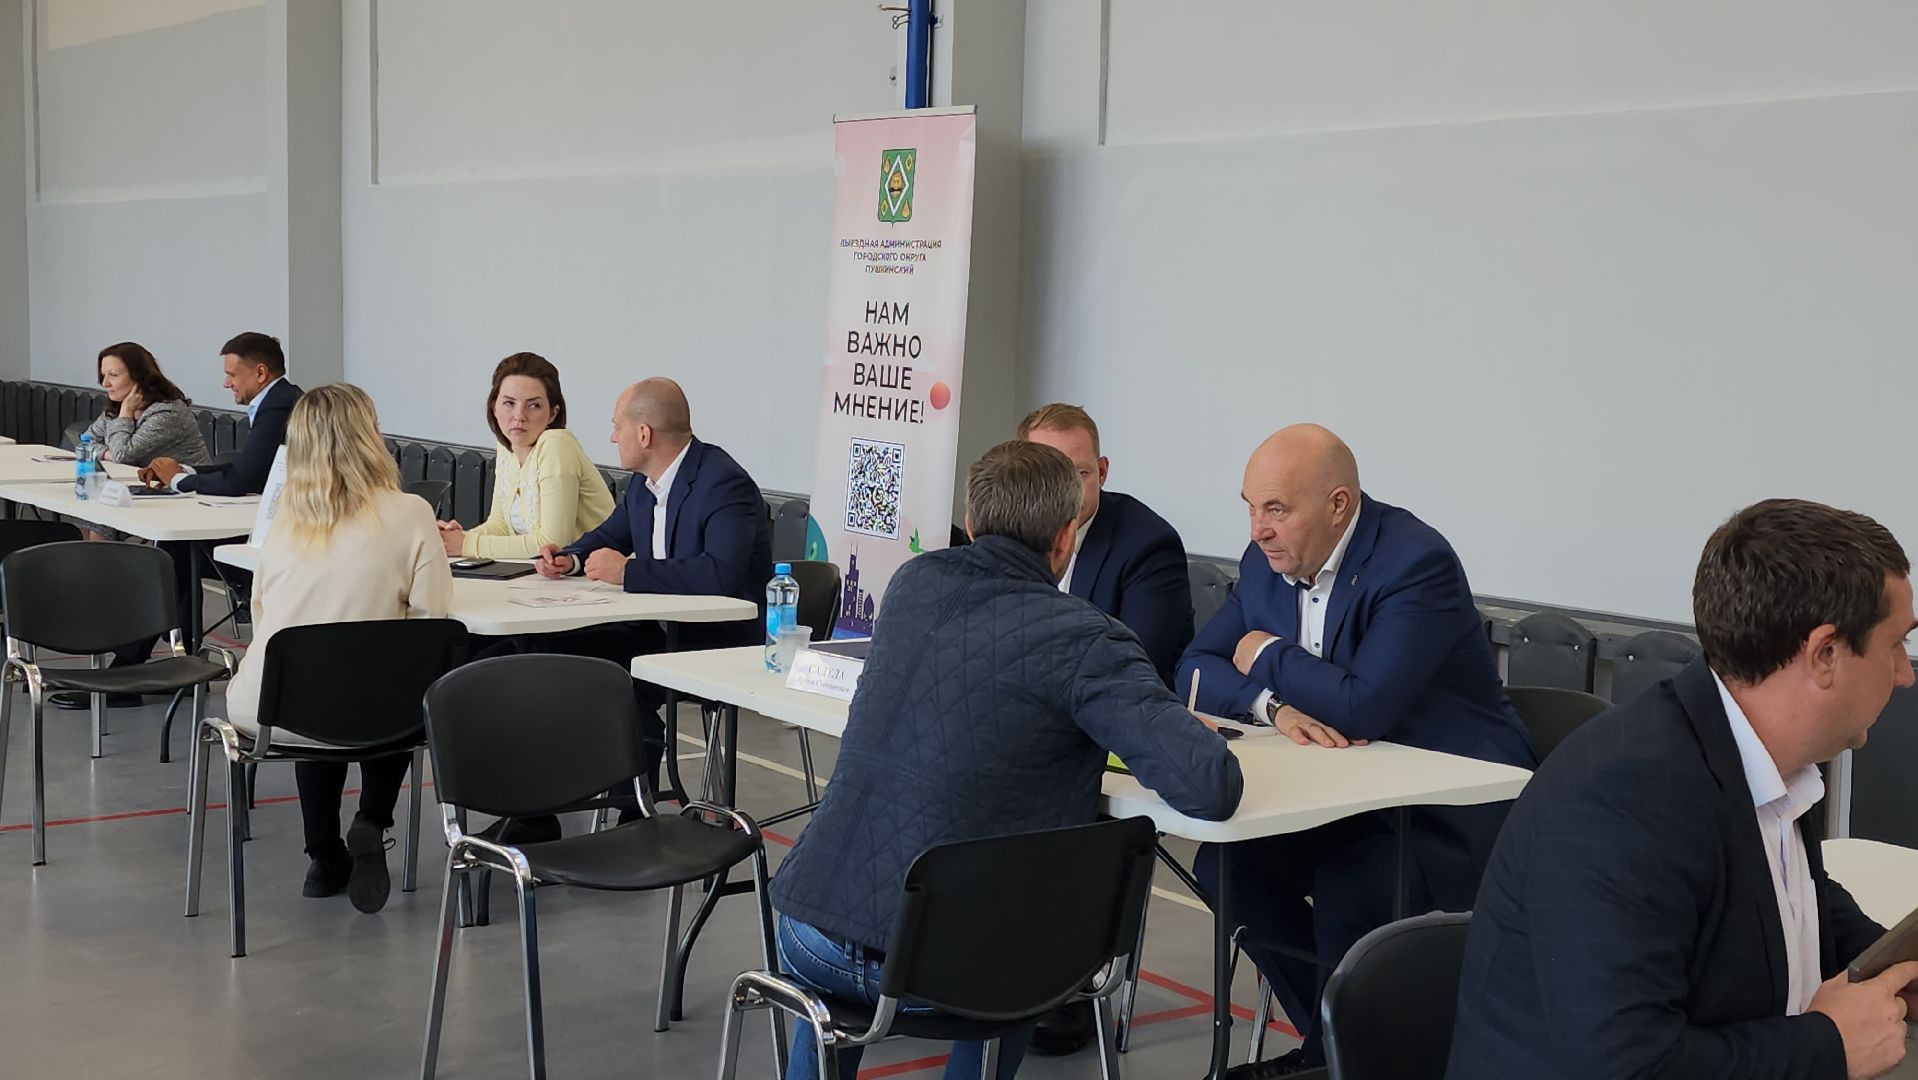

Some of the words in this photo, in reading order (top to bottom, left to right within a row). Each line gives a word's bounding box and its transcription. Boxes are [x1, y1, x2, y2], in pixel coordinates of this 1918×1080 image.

[853, 251, 898, 262] ГОРОДСКОГО
[899, 252, 927, 262] ОКРУГА
[880, 239, 942, 249] АДМИНИСТРАЦИЯ
[865, 264, 914, 275] ПУШКИНСКИЙ
[865, 300, 910, 326] НАМ
[847, 330, 921, 359] ВАЖНО
[853, 362, 912, 390] ВАШЕ
[833, 391, 924, 424] МНЕНИЕ!
